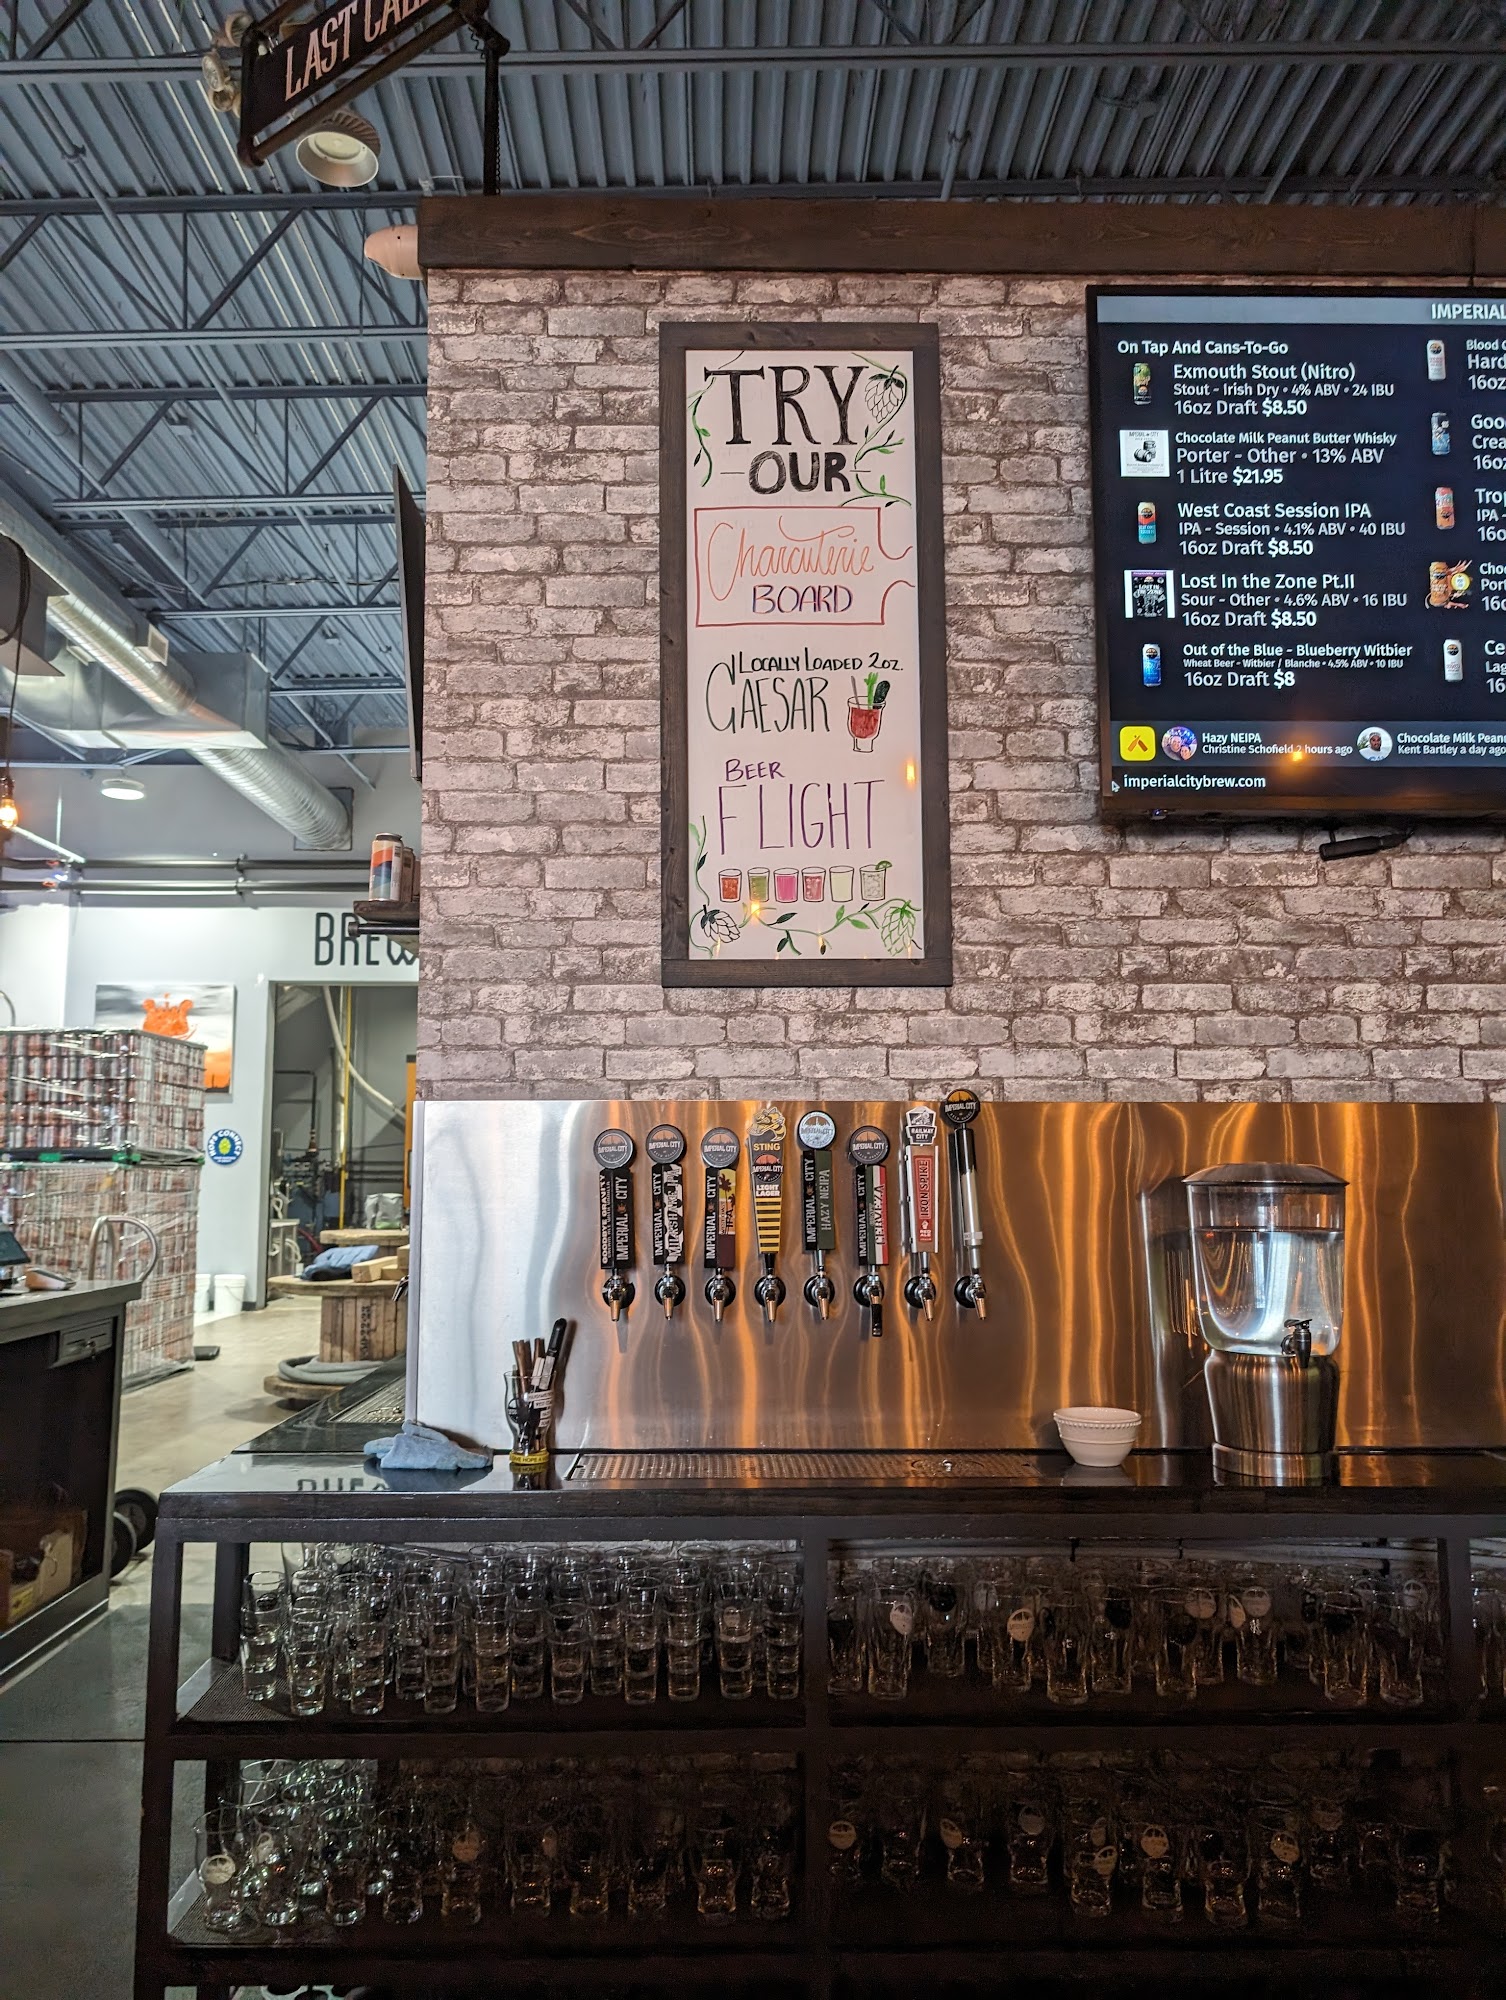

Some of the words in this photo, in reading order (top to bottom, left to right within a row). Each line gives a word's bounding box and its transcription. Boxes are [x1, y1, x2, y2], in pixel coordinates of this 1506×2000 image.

[285, 0, 358, 101] LAST
[1118, 341, 1138, 353] On
[1142, 341, 1168, 356] Tap
[1172, 340, 1201, 354] And
[1205, 341, 1288, 354] Cans-To-Go
[1466, 339, 1499, 350] Blood
[1468, 354, 1506, 369] Hard
[1174, 364, 1246, 379] Exmouth
[1252, 365, 1297, 379] Stout
[1301, 362, 1355, 382] (Nitro)
[1174, 383, 1210, 395] Stout
[1224, 382, 1252, 395] Irish
[1257, 384, 1279, 399] Dry
[1291, 384, 1311, 396] 4%
[1314, 384, 1340, 396] ABV
[1352, 384, 1368, 396] 24
[1372, 384, 1394, 396] IBU
[1469, 375, 1506, 390] 16oz
[704, 366, 869, 445] TRY
[1175, 400, 1212, 414] 16oz
[1217, 400, 1258, 414] Draft
[1262, 399, 1307, 417] $8.50
[1176, 432, 1235, 443] Chocolate
[1239, 432, 1264, 443] Milk
[1268, 433, 1310, 443] Peanut
[1313, 433, 1351, 443] Butter
[1353, 432, 1397, 446] Whisky
[1177, 448, 1230, 463] Porter
[1248, 447, 1296, 463] Other
[1313, 448, 1346, 463] 13%
[1351, 448, 1384, 463] ABV
[750, 451, 850, 494] OUR
[1177, 469, 1184, 483] 1
[1191, 468, 1228, 483] Litre
[1233, 467, 1283, 485] $21.95
[1178, 503, 1220, 517] West
[1224, 503, 1271, 517] Coast
[1275, 502, 1339, 518] Session
[1345, 503, 1371, 518] IPA
[1477, 509, 1499, 521] IPA
[1179, 522, 1201, 535] IPA
[1216, 522, 1270, 535] Session
[1284, 523, 1314, 535] 4.1%
[1318, 523, 1346, 535] ABV
[1359, 523, 1376, 535] 40
[1381, 522, 1405, 535] IBU
[1180, 541, 1217, 555] 16oz
[1222, 540, 1264, 555] Draft
[1268, 538, 1313, 557] $8.50
[708, 515, 874, 600] Charcuterie
[1182, 574, 1217, 588] Lost
[1222, 574, 1237, 588] In
[1243, 573, 1270, 588] the
[1275, 574, 1317, 588] Zone
[1323, 574, 1354, 588] Pt.II
[753, 585, 852, 613] BOARD
[1181, 593, 1215, 606] Sour
[1230, 593, 1271, 606] Other
[1284, 593, 1318, 606] 4.6%
[1321, 594, 1349, 606] ABV
[1362, 594, 1378, 606] 16
[1383, 594, 1407, 606] IBU
[1182, 612, 1220, 626] 16oz
[1225, 611, 1267, 626] Draft
[1271, 609, 1317, 629] $8.50
[739, 651, 799, 674] LOCALLY
[804, 647, 862, 671] LOADED
[1183, 644, 1207, 655] Out
[1211, 644, 1225, 655] of
[1227, 643, 1250, 656] the
[1254, 643, 1283, 656] Blue
[1297, 643, 1361, 659] Blueberry
[1364, 643, 1413, 656] Witbier
[1183, 658, 1212, 667] Wheat
[1214, 659, 1235, 667] Beer
[1242, 659, 1275, 667] Witbier
[1285, 659, 1320, 668] Blanche
[1329, 659, 1349, 668] 4.5%
[1351, 658, 1368, 668] ABV
[1377, 659, 1386, 668] 10
[1388, 659, 1403, 668] IBU
[1184, 672, 1222, 686] 16oz
[1228, 671, 1270, 686] Draft
[1274, 669, 1295, 689] $8
[706, 655, 830, 734] CAESAR
[1202, 733, 1228, 745] Hazy
[1231, 733, 1262, 743] NEIPA
[1397, 732, 1450, 743] Chocolate
[1453, 732, 1476, 743] Milk
[1202, 744, 1246, 753] Christine
[1249, 744, 1294, 755] Schofield
[1305, 744, 1332, 754] hours
[1335, 746, 1353, 757] ago
[1398, 745, 1421, 755] Kent
[1423, 745, 1458, 757] Bartley
[1460, 746, 1467, 754] a
[1469, 744, 1487, 756] day
[1489, 746, 1506, 756] ago
[726, 759, 785, 781] BEER
[1124, 774, 1266, 790] imperialcitybrew.com
[718, 780, 885, 855] FLIGHT
[945, 1104, 966, 1113] IMPERIAL
[966, 1102, 977, 1110] CITY
[648, 1141, 669, 1150] IMPERIAL
[670, 1140, 681, 1148] CITY
[753, 1143, 780, 1151] STING
[852, 1143, 873, 1151] IMPERIAL
[873, 1142, 885, 1150] CITY
[773, 1165, 784, 1173] CITY
[805, 1158, 815, 1182] CITY
[919, 1160, 929, 1191] SPIKE
[615, 1177, 628, 1199] CITY
[653, 1173, 662, 1195] CITY
[707, 1176, 716, 1198] CITY
[819, 1169, 831, 1200] NEIPA
[857, 1173, 865, 1196] CITY
[920, 1192, 929, 1216] IRON
[668, 1190, 681, 1256] MILKSHAKE
[725, 1209, 733, 1228] IPA
[806, 1195, 816, 1243] IMPERIAL
[820, 1202, 832, 1231] HAZY
[873, 1184, 886, 1245] CERVEZA
[616, 1214, 629, 1260] IMPERIAL
[654, 1209, 663, 1256] IMPERIAL
[706, 1212, 716, 1259] IMPERIAL
[859, 1210, 867, 1257] IMPERIAL
